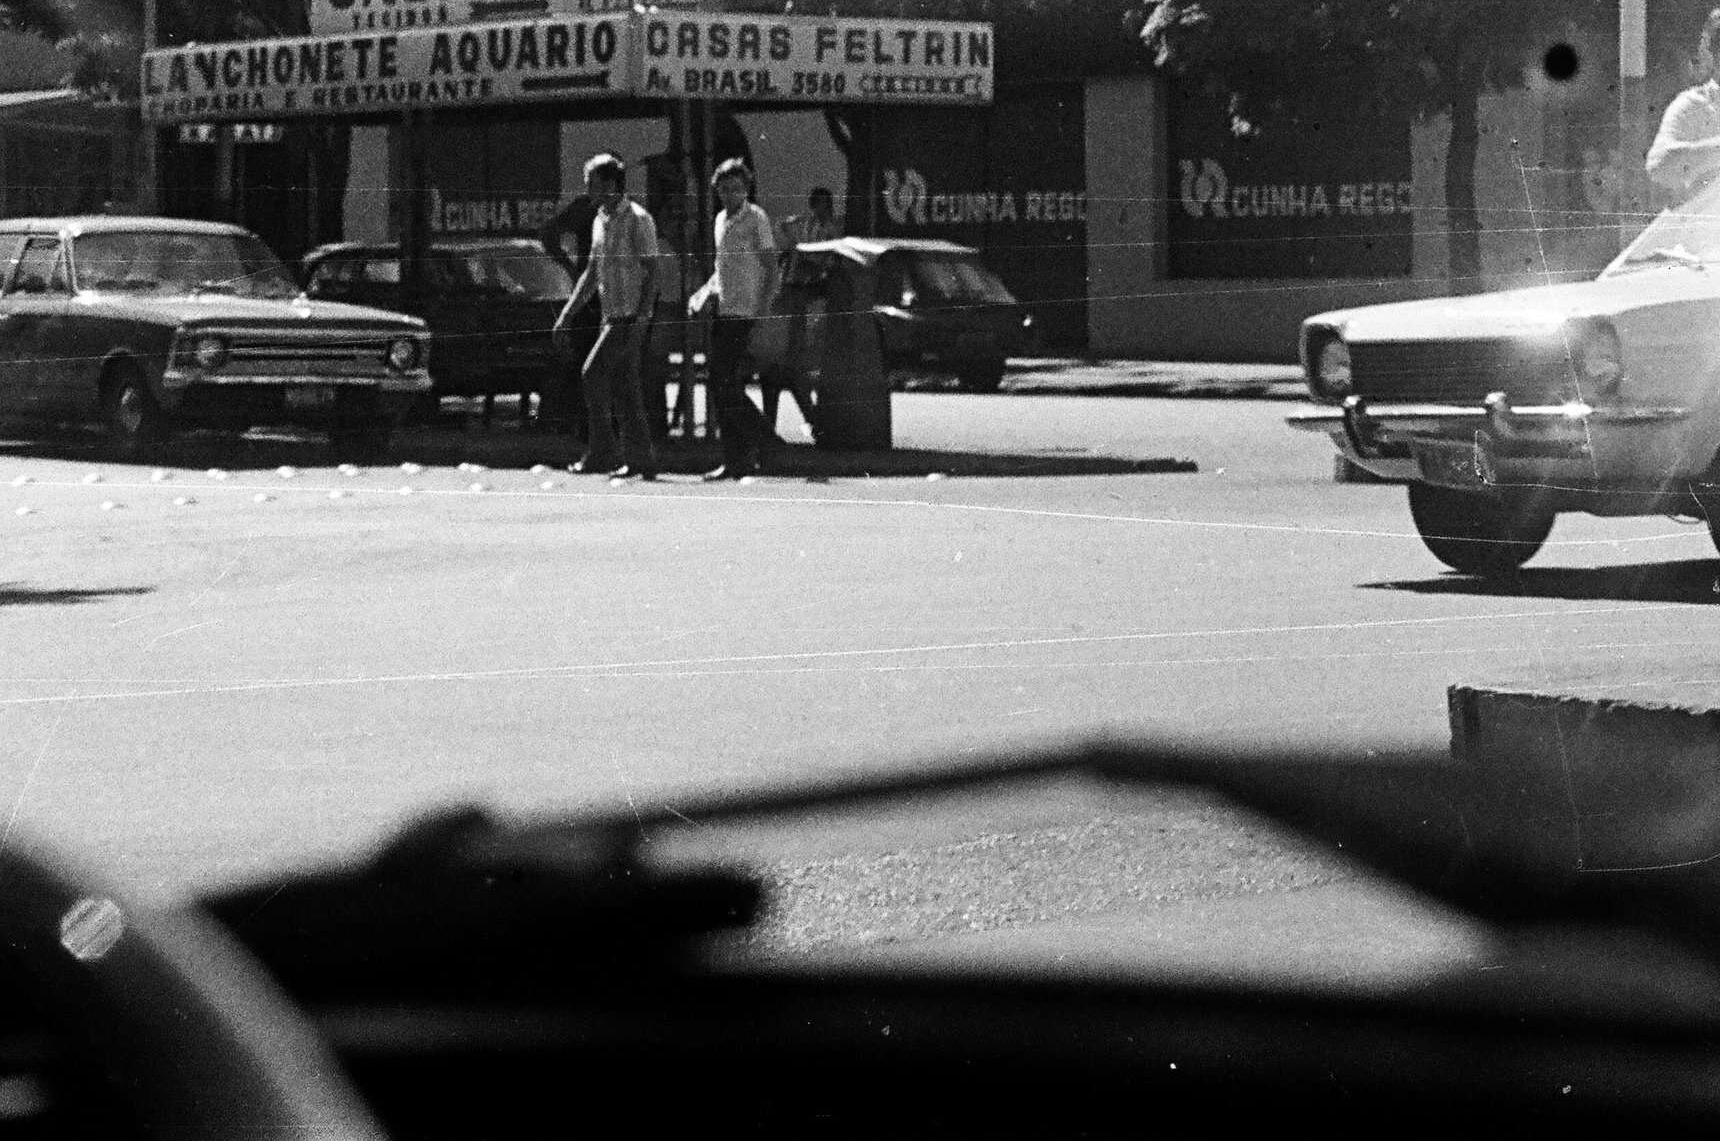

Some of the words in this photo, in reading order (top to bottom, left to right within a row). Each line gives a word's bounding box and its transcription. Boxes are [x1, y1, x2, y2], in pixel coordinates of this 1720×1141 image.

[145, 35, 399, 95] LANCHONETE
[430, 22, 617, 76] AQUARIO
[646, 20, 792, 61] CASAS
[815, 26, 990, 68] FELTRIN
[312, 78, 493, 106] RESTAURANTE
[684, 68, 778, 93] BRASIL
[932, 192, 1018, 223] CUNHA
[1232, 184, 1331, 217] CUNHA
